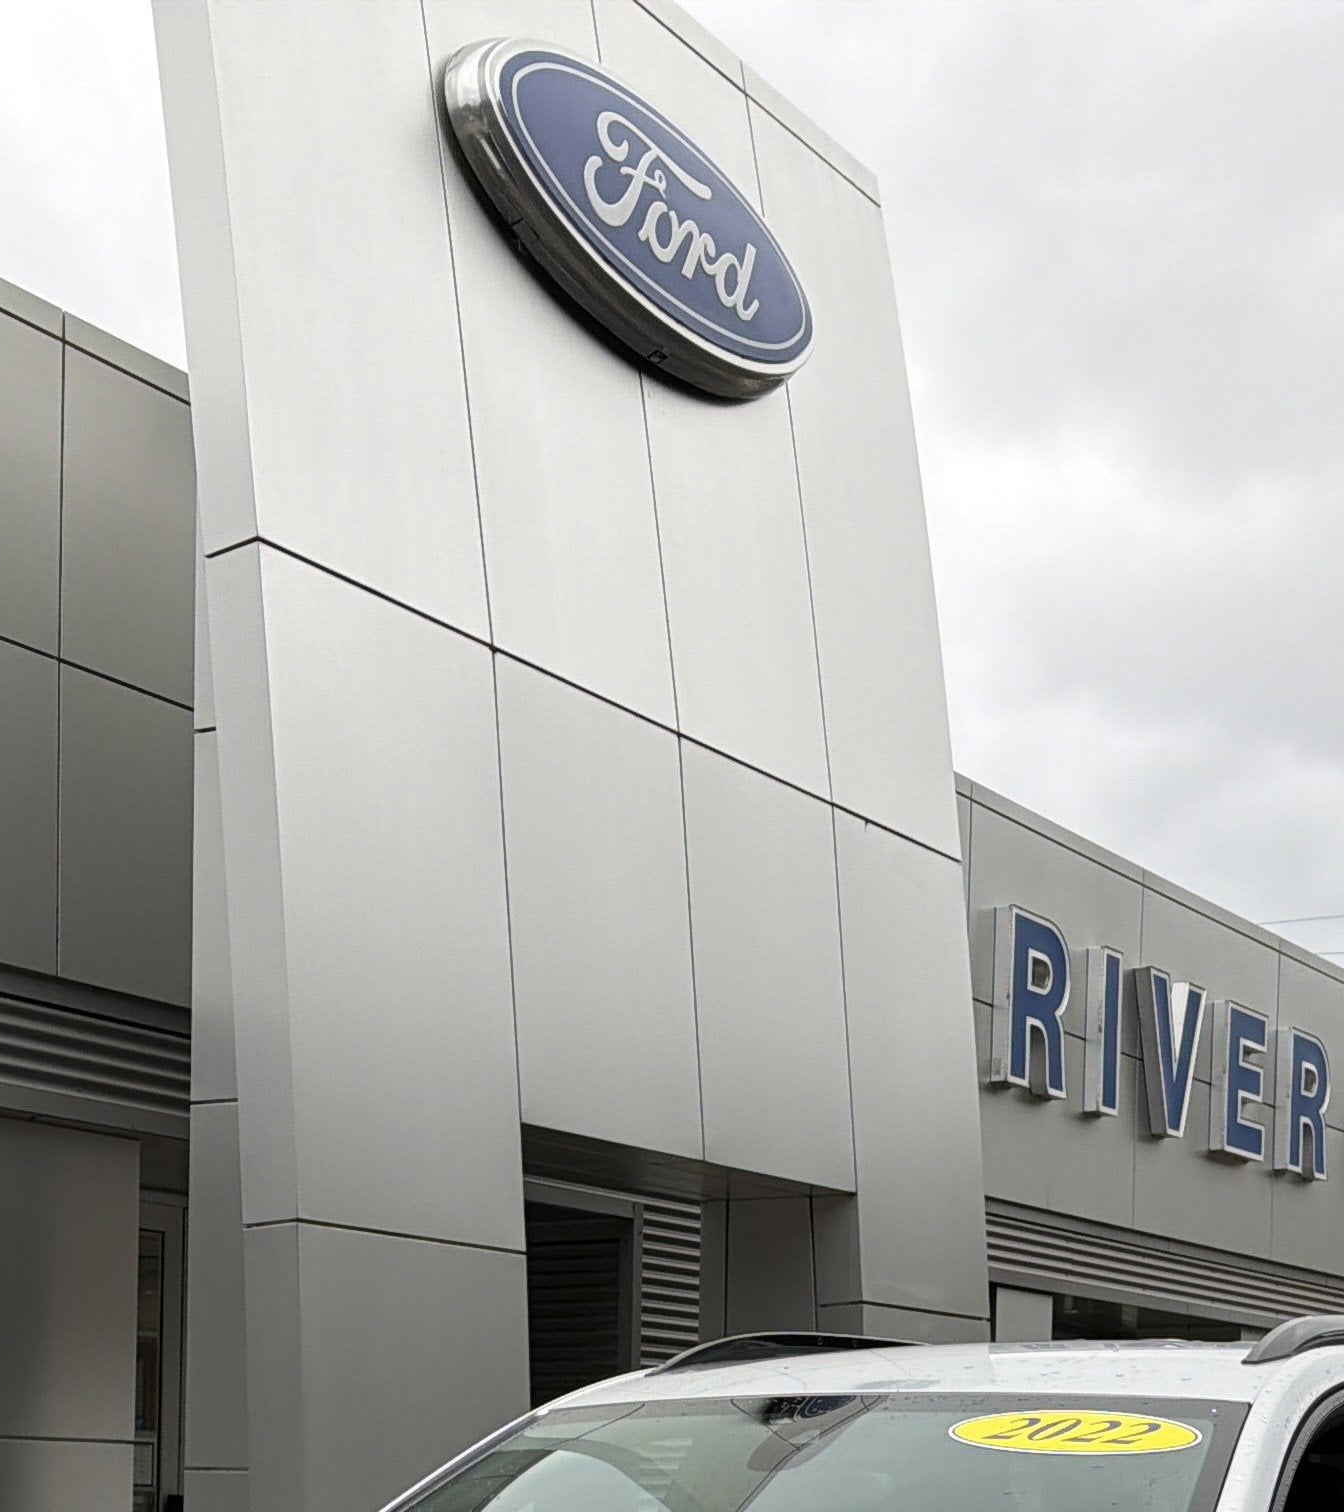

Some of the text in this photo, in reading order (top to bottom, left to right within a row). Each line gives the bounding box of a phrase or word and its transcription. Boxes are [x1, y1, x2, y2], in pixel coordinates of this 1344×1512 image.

[583, 110, 760, 322] Ford
[991, 904, 1332, 1182] RIVER
[981, 1417, 1162, 1445] 2022
